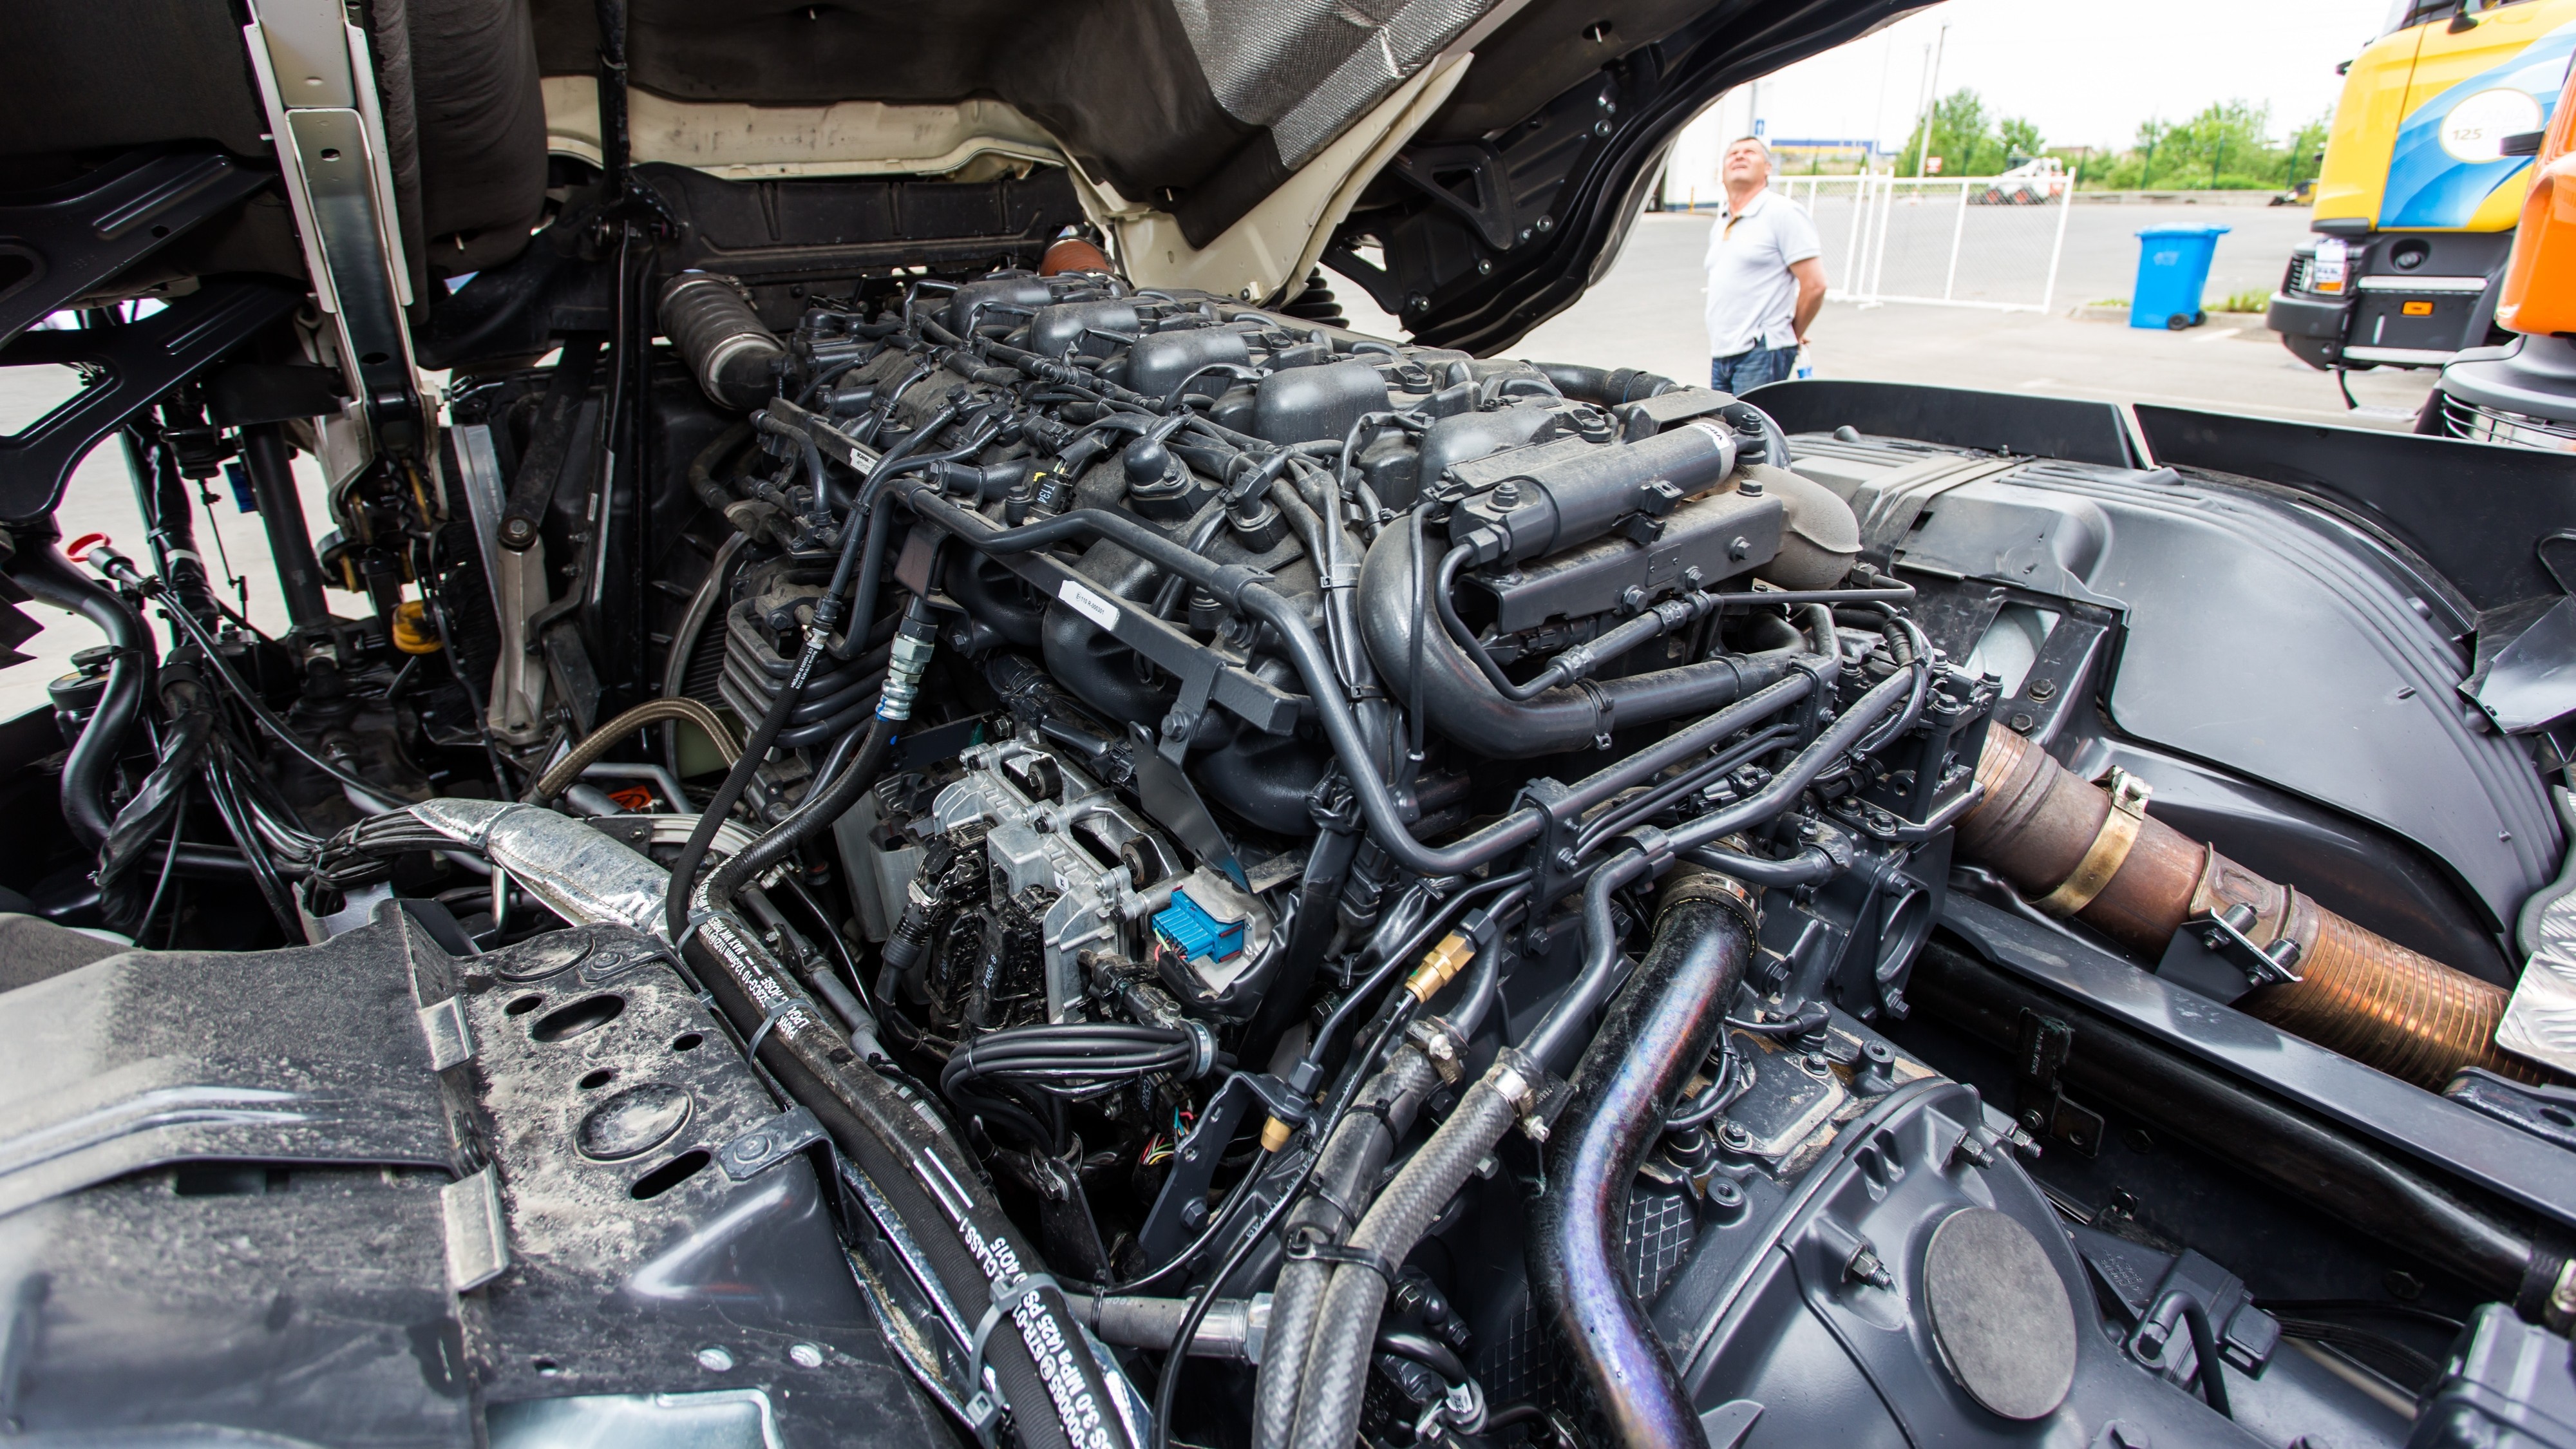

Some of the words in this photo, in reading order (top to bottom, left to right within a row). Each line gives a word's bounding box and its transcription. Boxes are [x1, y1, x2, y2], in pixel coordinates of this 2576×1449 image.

[2452, 128, 2483, 140] 125
[1037, 484, 1056, 504] T134
[708, 916, 727, 934] PRES
[719, 929, 735, 942] WK
[728, 938, 748, 954] MAX
[959, 1217, 969, 1233] 1
[965, 1226, 998, 1277] CLASS
[990, 1237, 1019, 1274] 4Q15
[1036, 1314, 1065, 1353] (425
[1058, 1349, 1086, 1396] MPa
